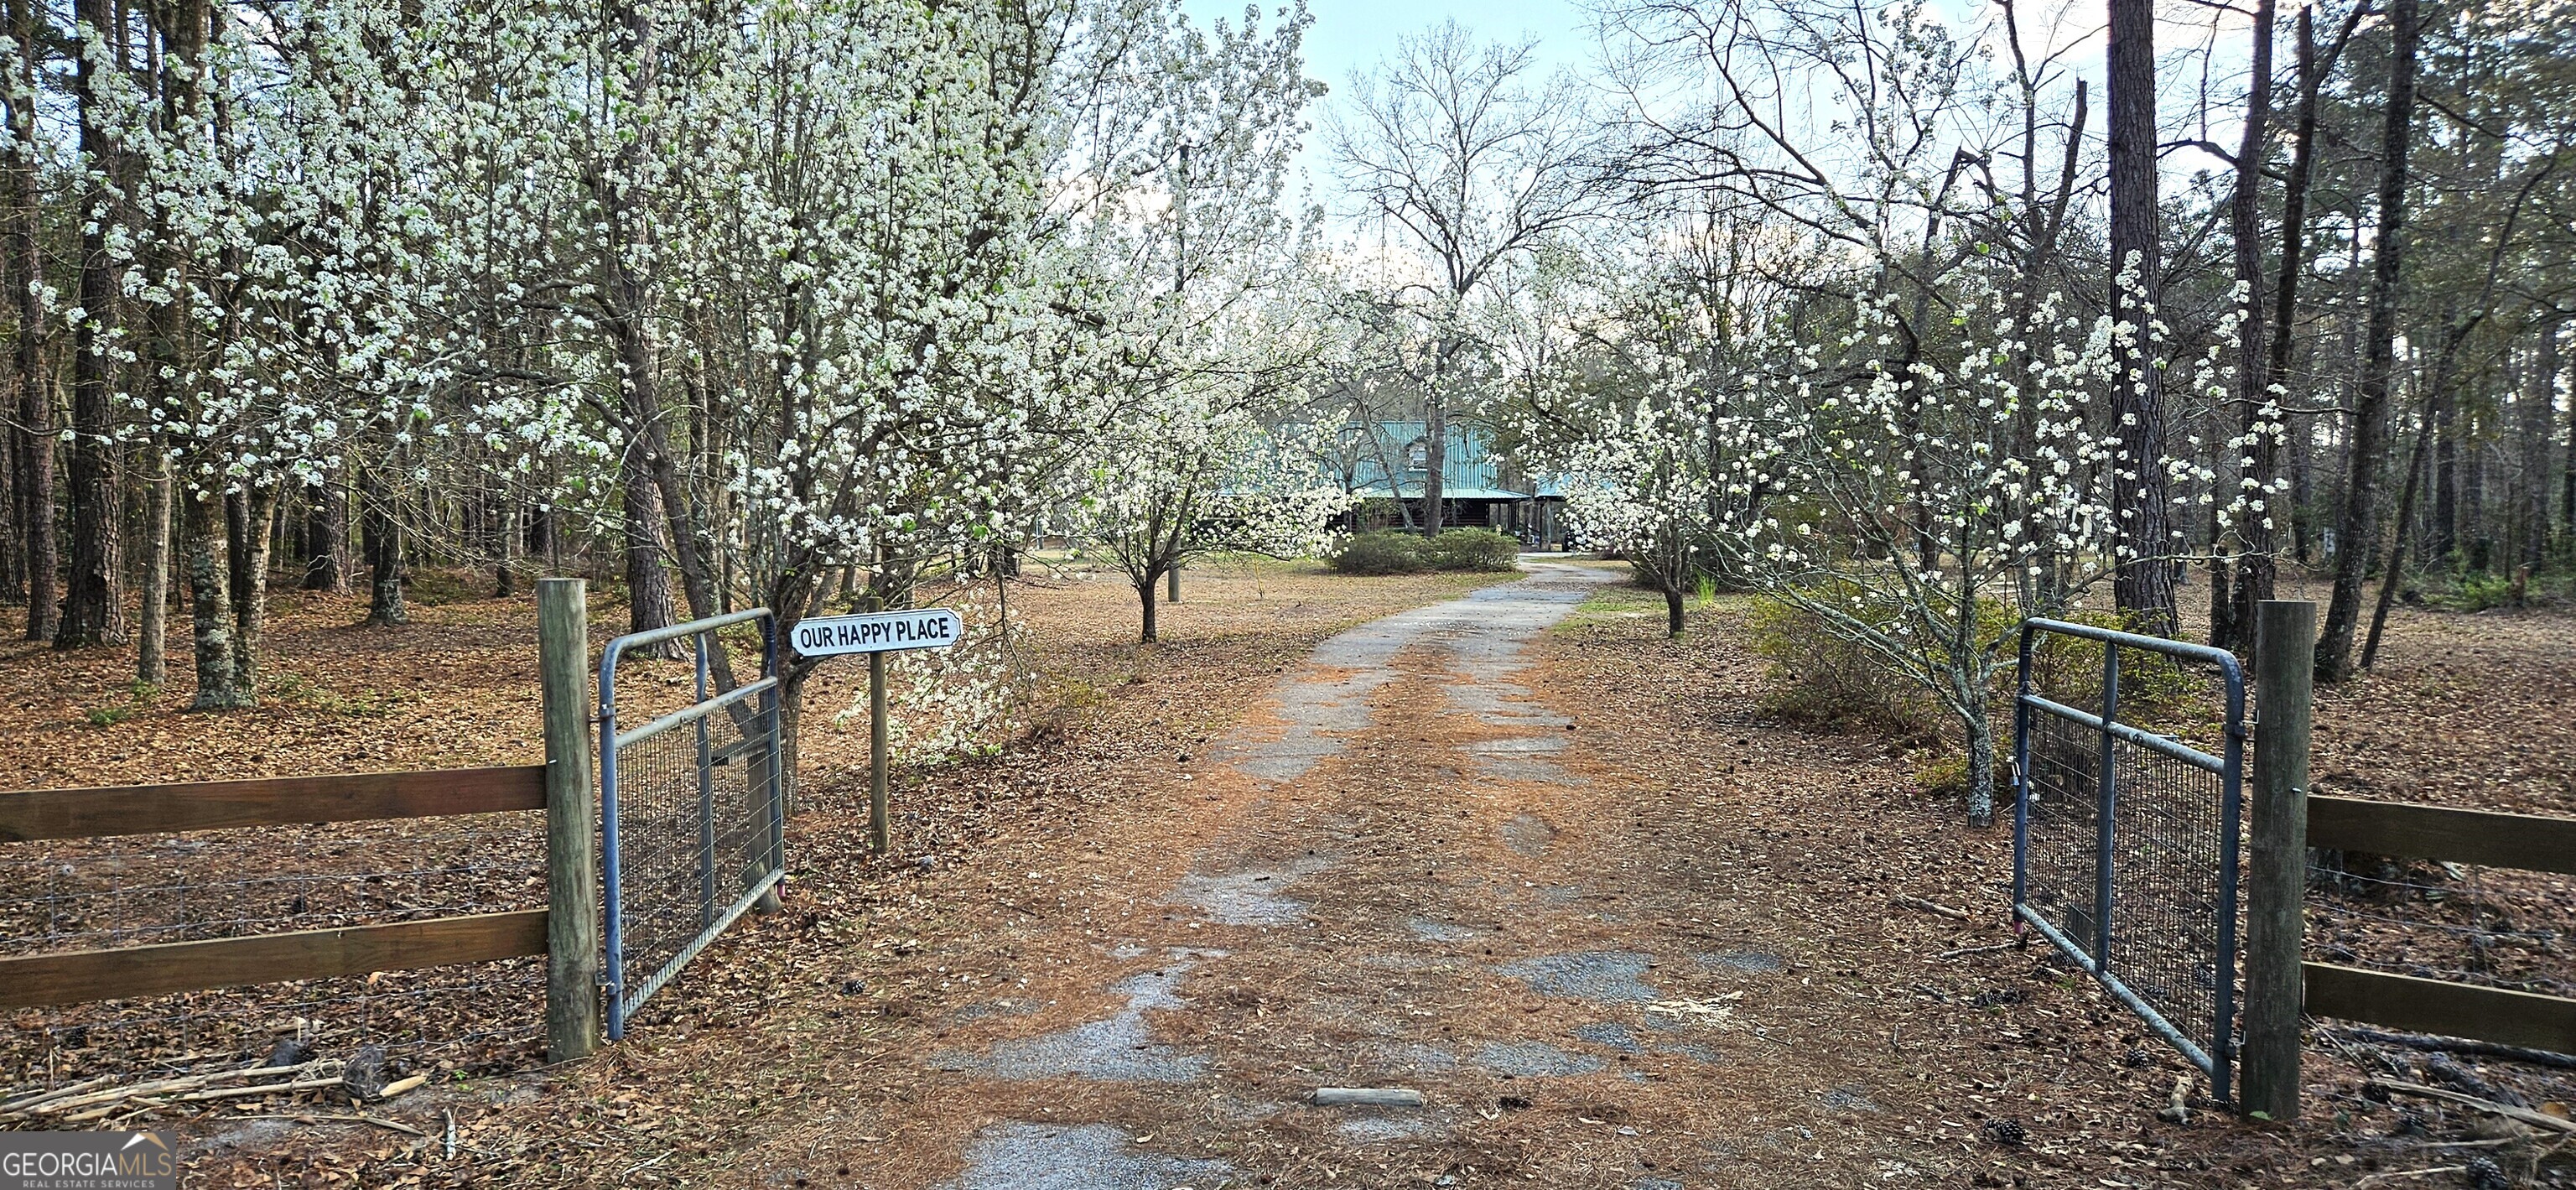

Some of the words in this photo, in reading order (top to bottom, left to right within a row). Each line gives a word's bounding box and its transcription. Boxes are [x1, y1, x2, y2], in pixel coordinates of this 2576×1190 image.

[800, 626, 834, 648] OUR
[838, 621, 891, 646] HAPPY
[896, 617, 950, 642] PLACE
